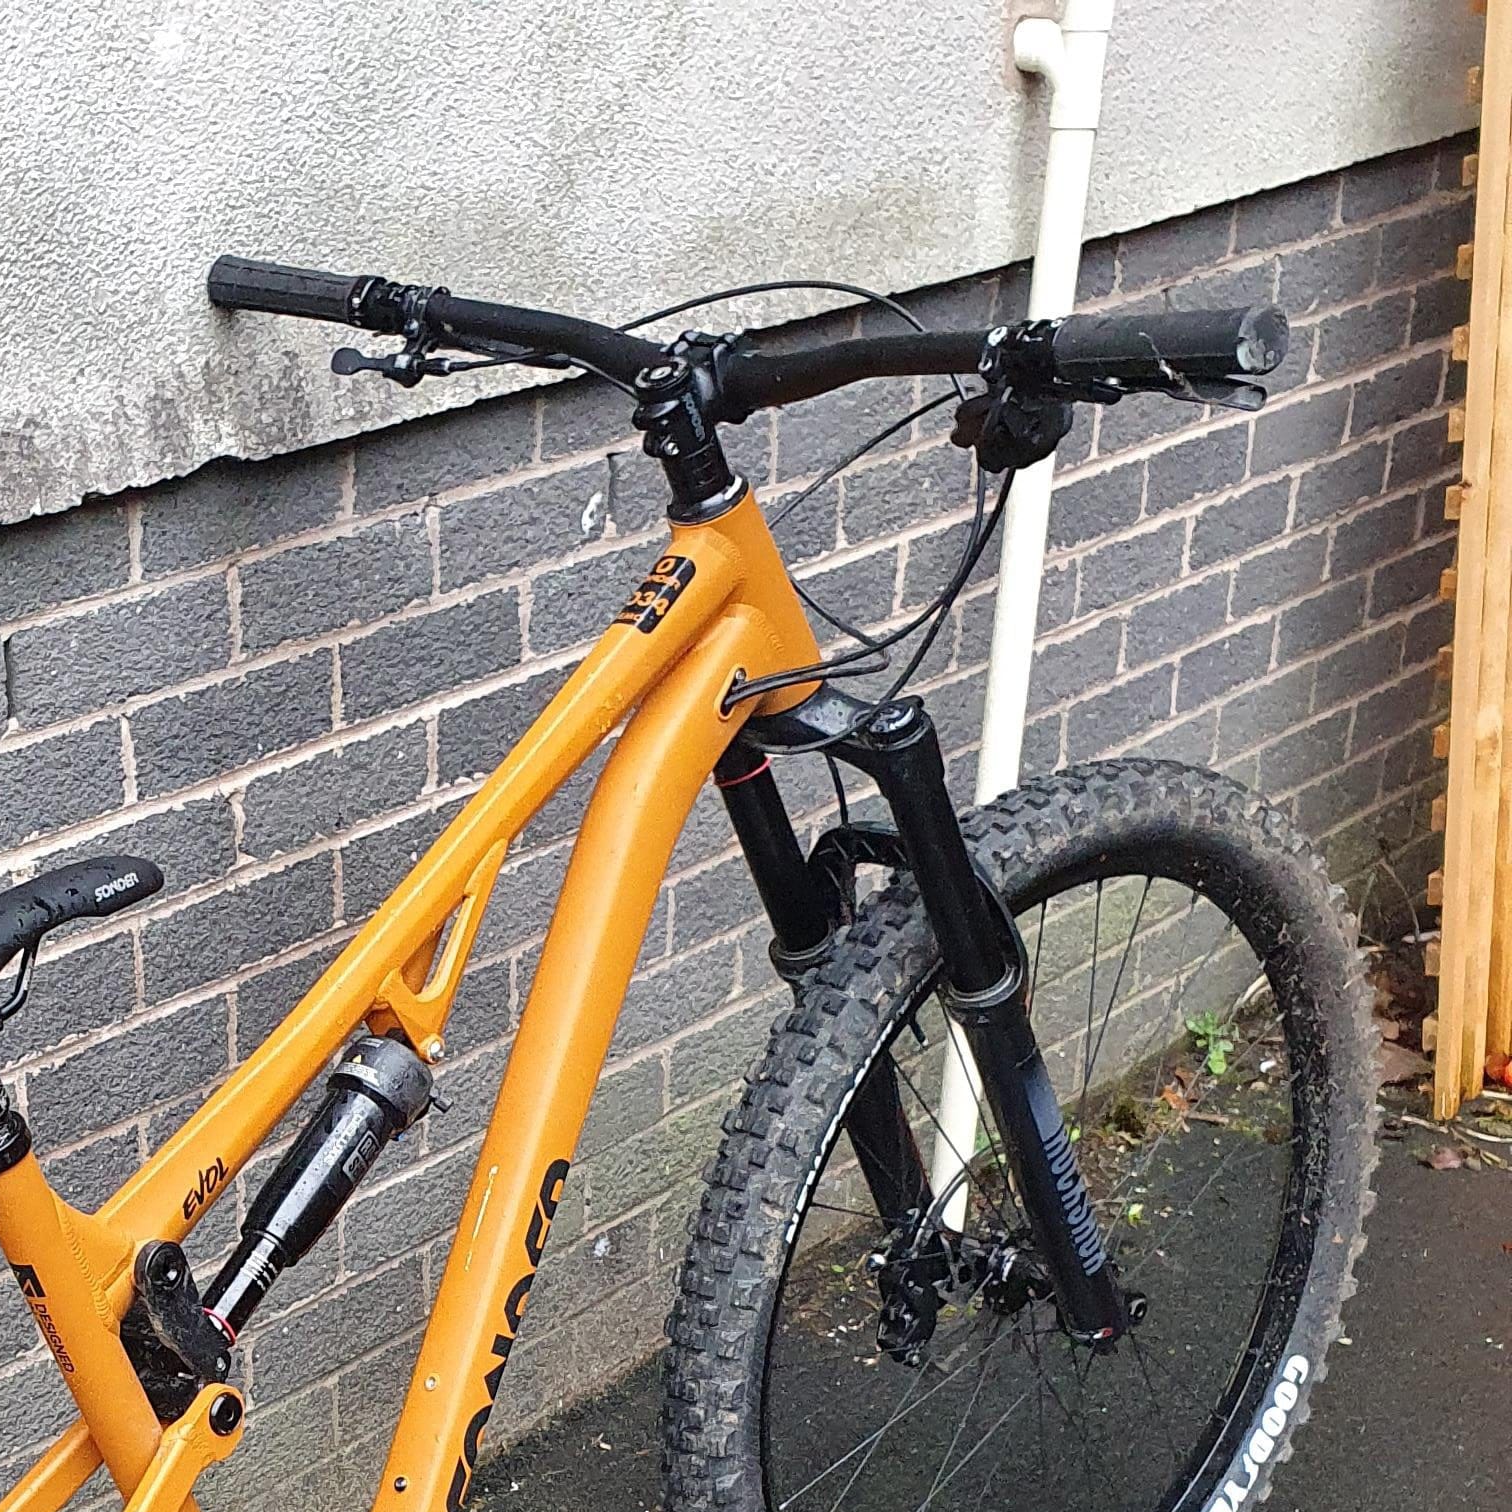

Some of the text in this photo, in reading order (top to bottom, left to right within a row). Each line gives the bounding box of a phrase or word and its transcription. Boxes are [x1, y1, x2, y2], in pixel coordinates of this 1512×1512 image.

[94, 872, 140, 903] SONDER
[182, 1157, 229, 1220] EVOL
[34, 1303, 75, 1374] DESIGNED
